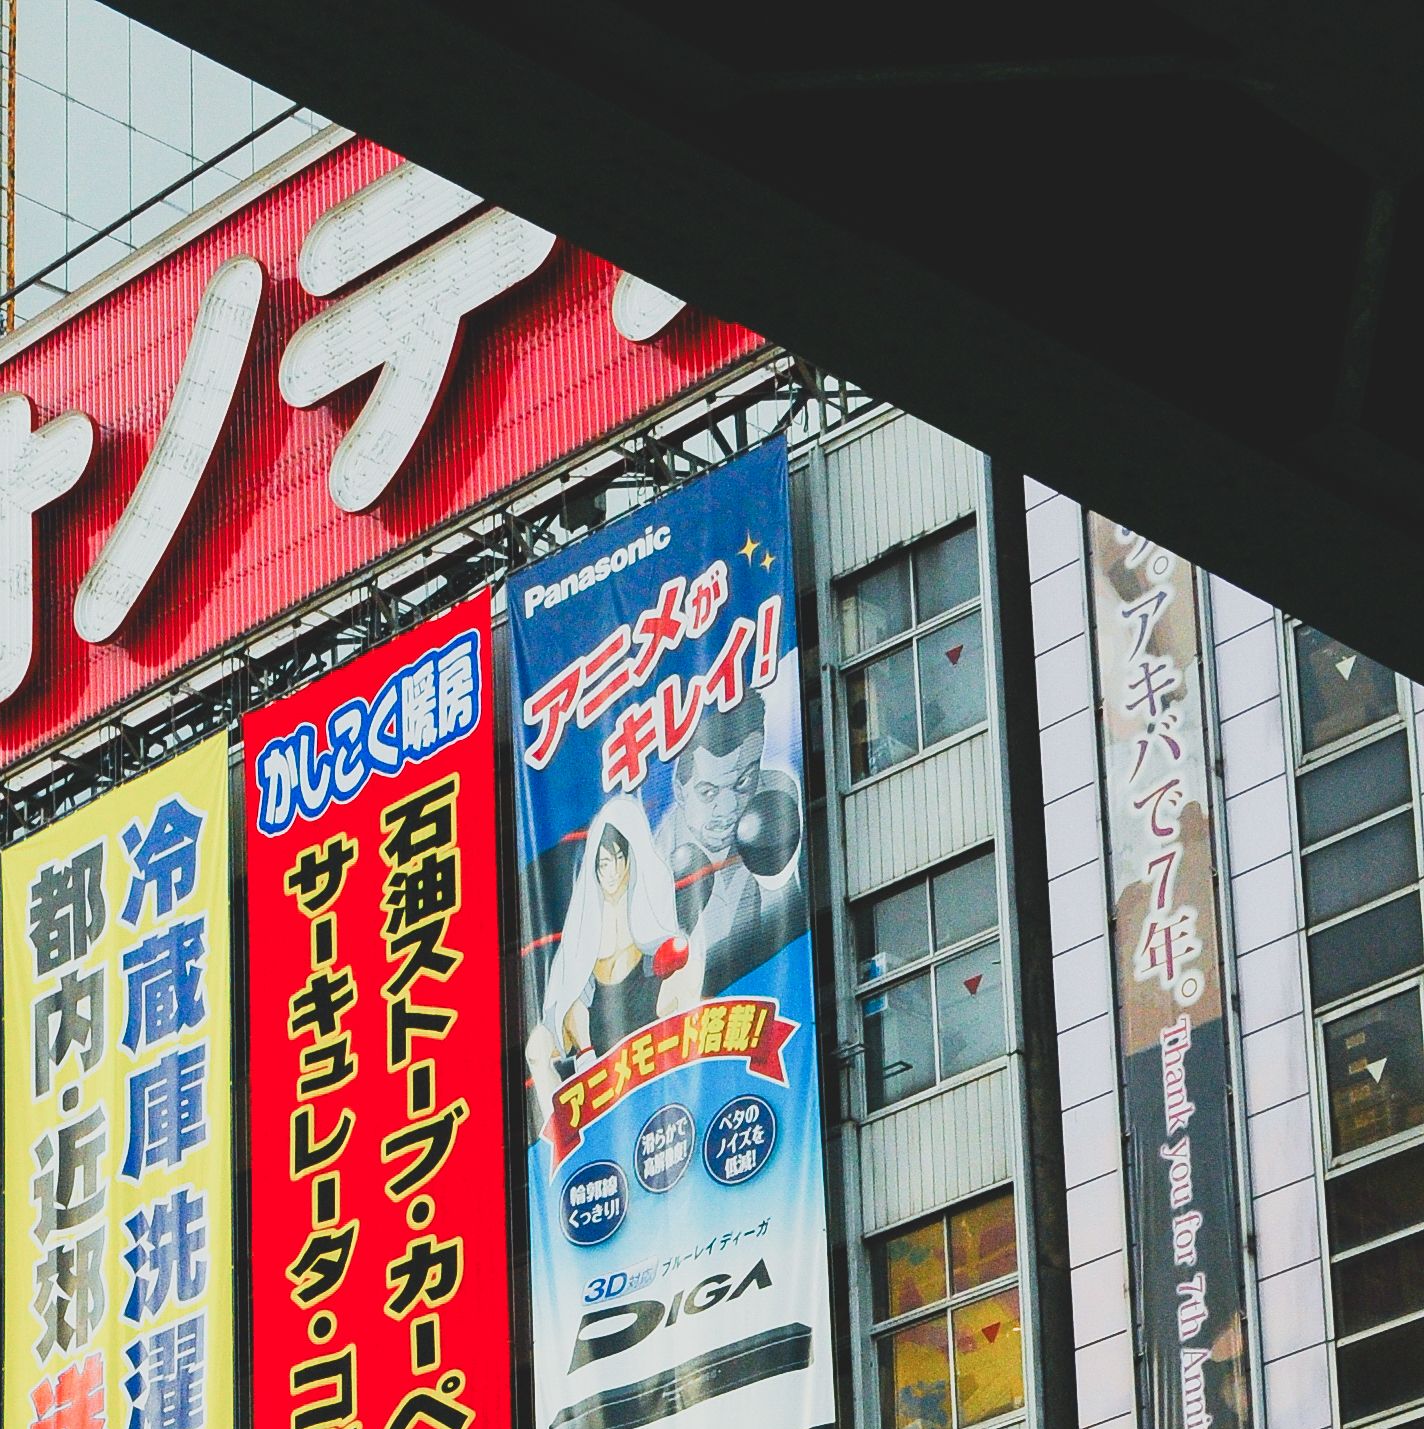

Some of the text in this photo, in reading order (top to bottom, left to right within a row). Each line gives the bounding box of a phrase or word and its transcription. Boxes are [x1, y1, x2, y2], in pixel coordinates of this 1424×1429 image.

[523, 525, 672, 619] Panasonic
[524, 560, 728, 770] アニメが
[601, 594, 782, 793] キレイ!
[257, 628, 482, 836] かしこく暖房
[1163, 1013, 1194, 1136] Thank
[1161, 1136, 1193, 1210] you
[1172, 1211, 1203, 1267] for
[566, 1257, 774, 1376] DIGA
[1177, 1272, 1209, 1342] 7th
